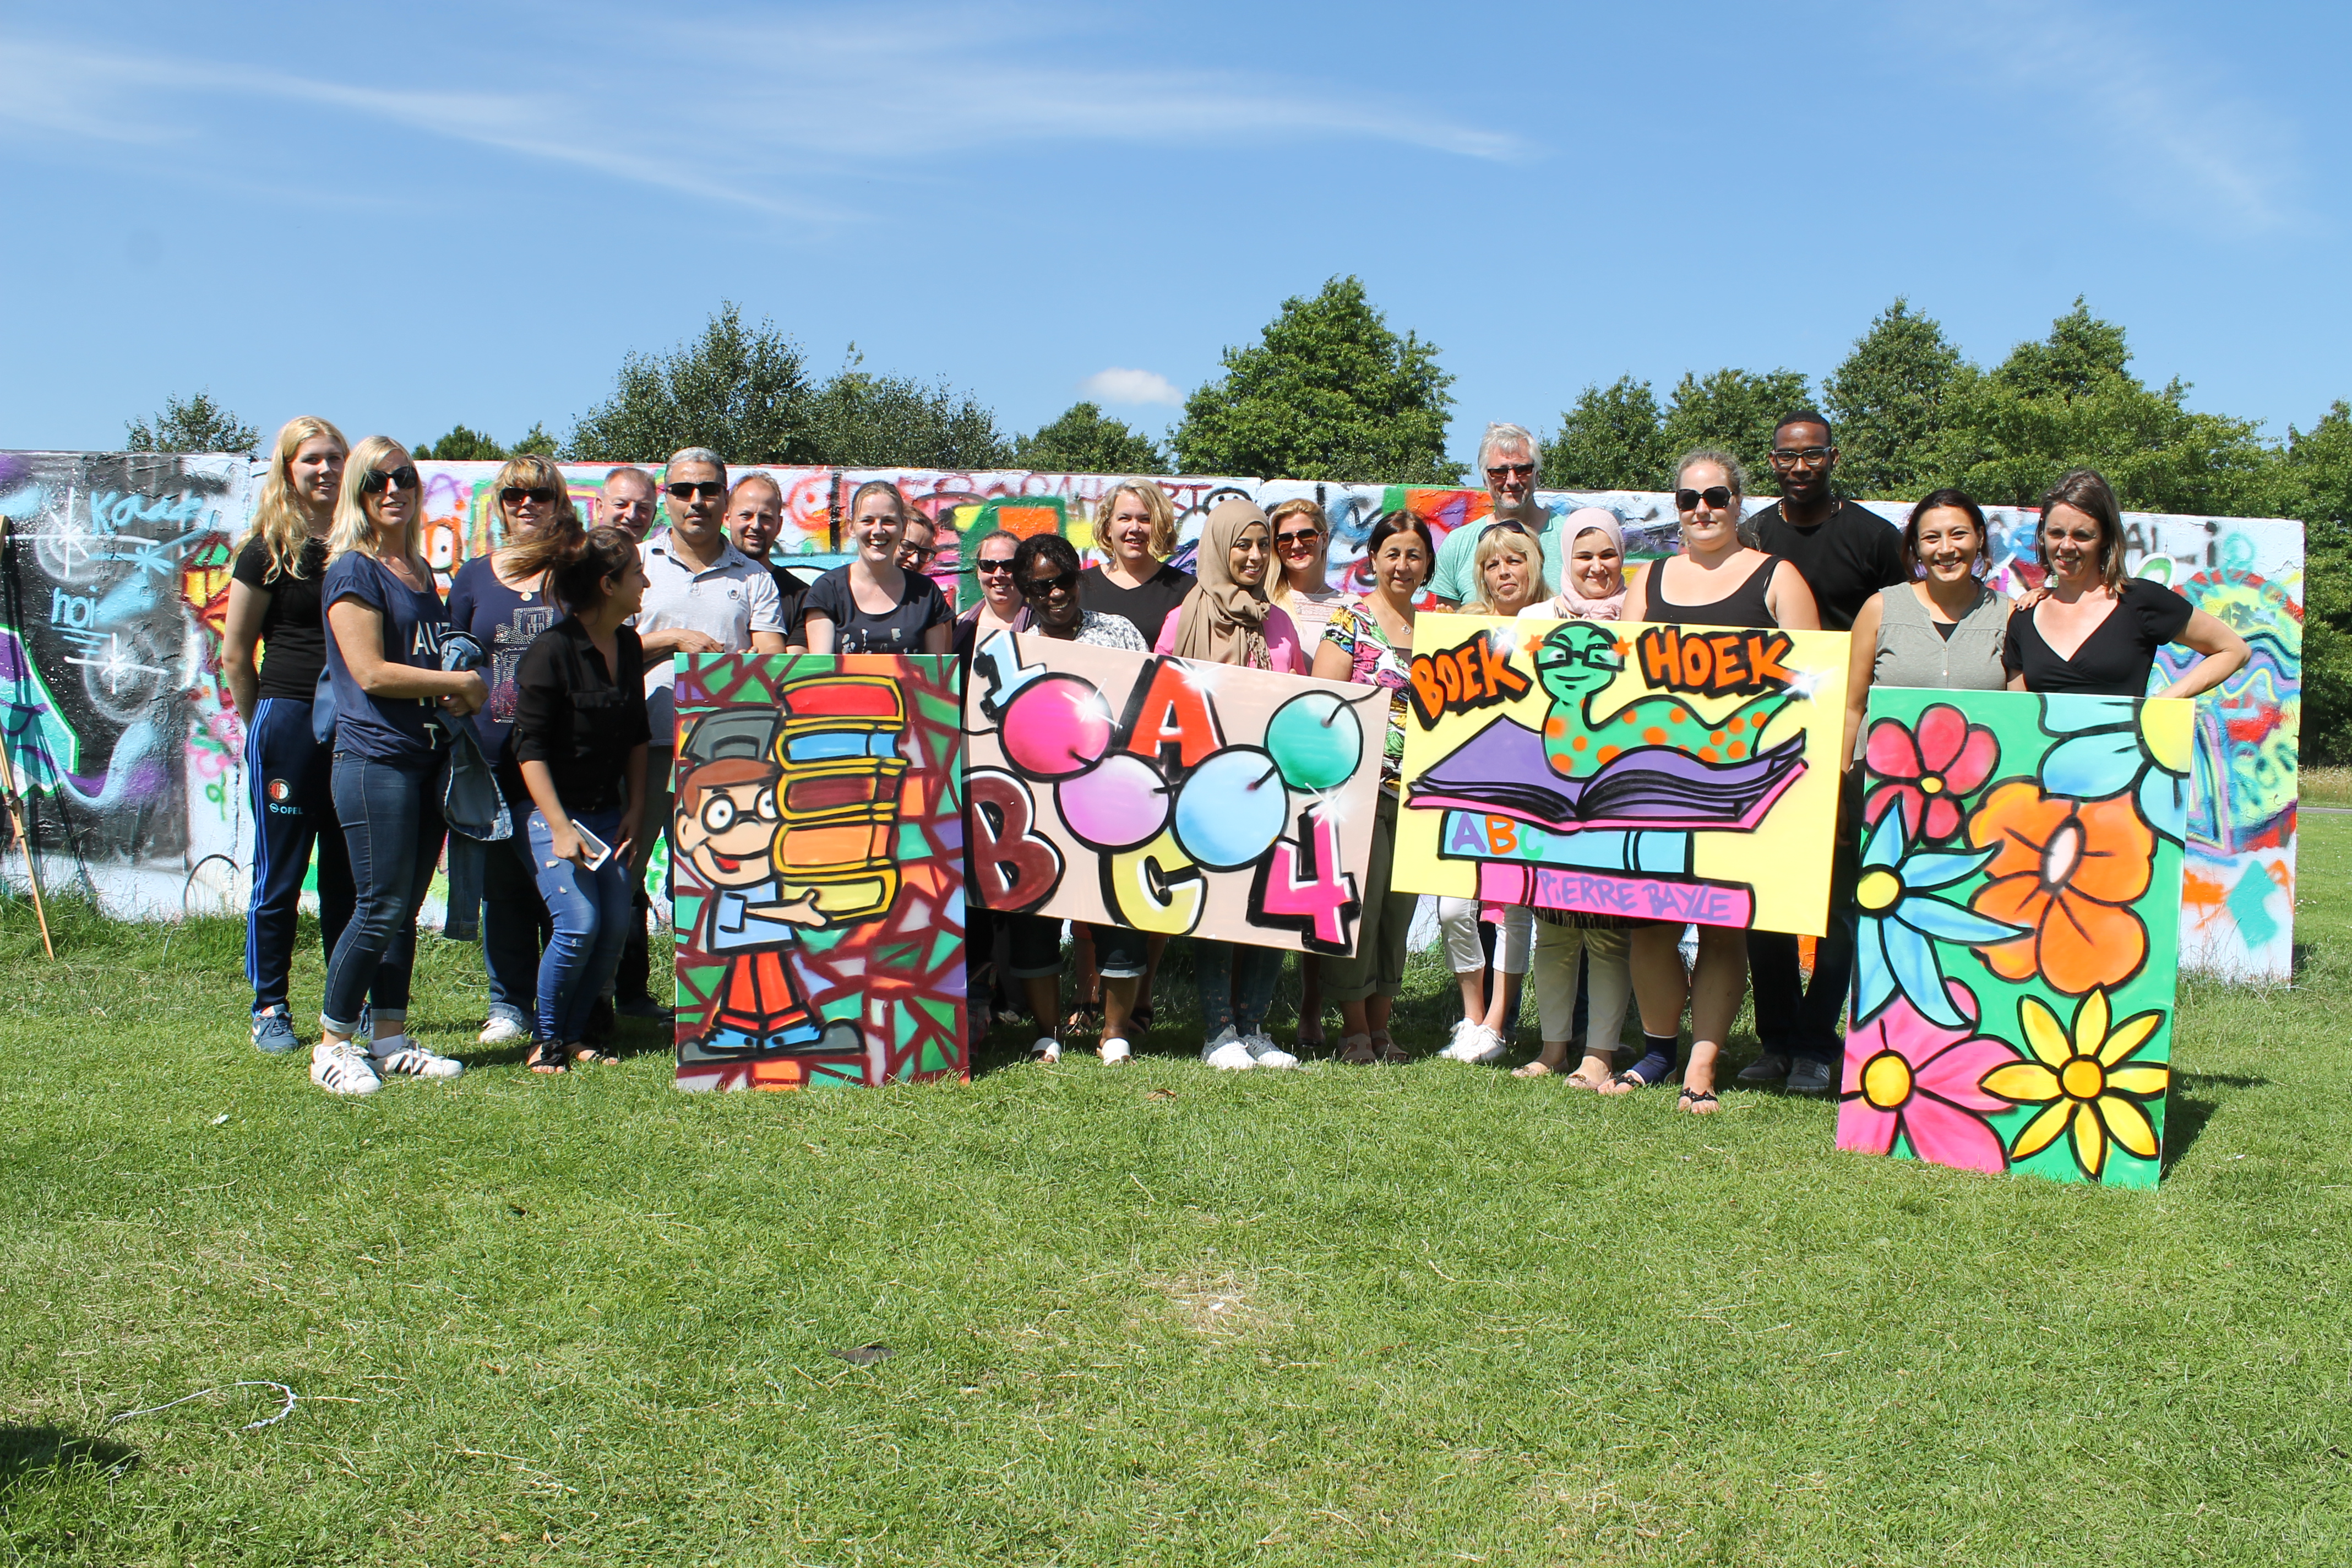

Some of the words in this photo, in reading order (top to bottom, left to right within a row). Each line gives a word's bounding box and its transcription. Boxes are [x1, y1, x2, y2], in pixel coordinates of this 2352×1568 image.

[1118, 656, 1226, 768] A
[1410, 632, 1531, 726] BOEK
[1638, 627, 1807, 695] HOEK
[280, 806, 303, 814] OPEL
[962, 767, 1065, 913] B
[1452, 812, 1544, 861] ABC
[1251, 804, 1361, 952] 4
[1642, 883, 1732, 921] BAYLE
